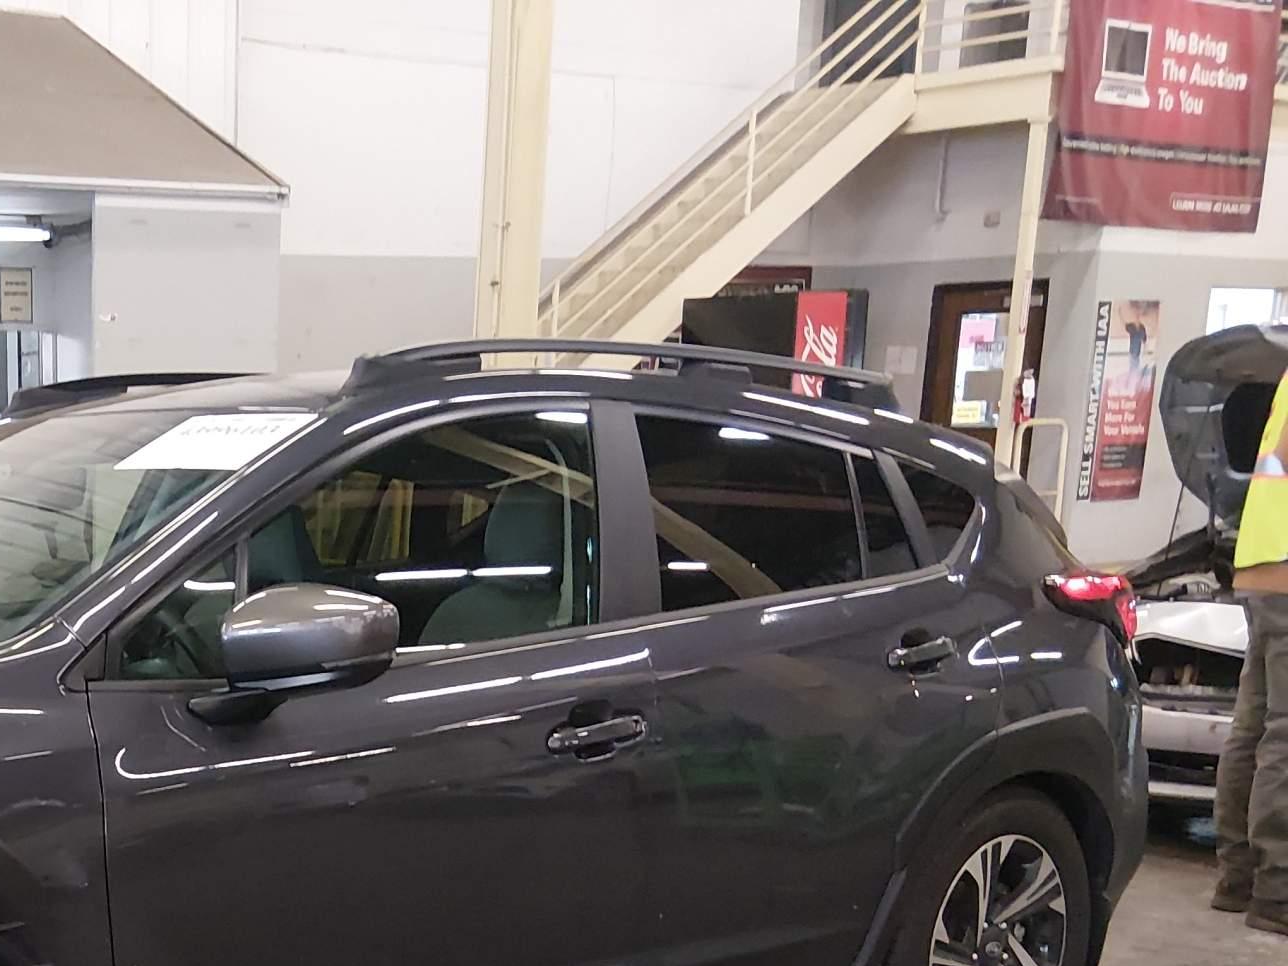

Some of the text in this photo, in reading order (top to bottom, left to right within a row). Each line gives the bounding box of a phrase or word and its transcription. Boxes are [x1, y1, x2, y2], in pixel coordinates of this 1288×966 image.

[1165, 26, 1228, 64] We Bring
[1162, 57, 1248, 92] The Auction
[1158, 86, 1204, 115] To You
[1078, 303, 1110, 497] SELL SMART WITH IAA
